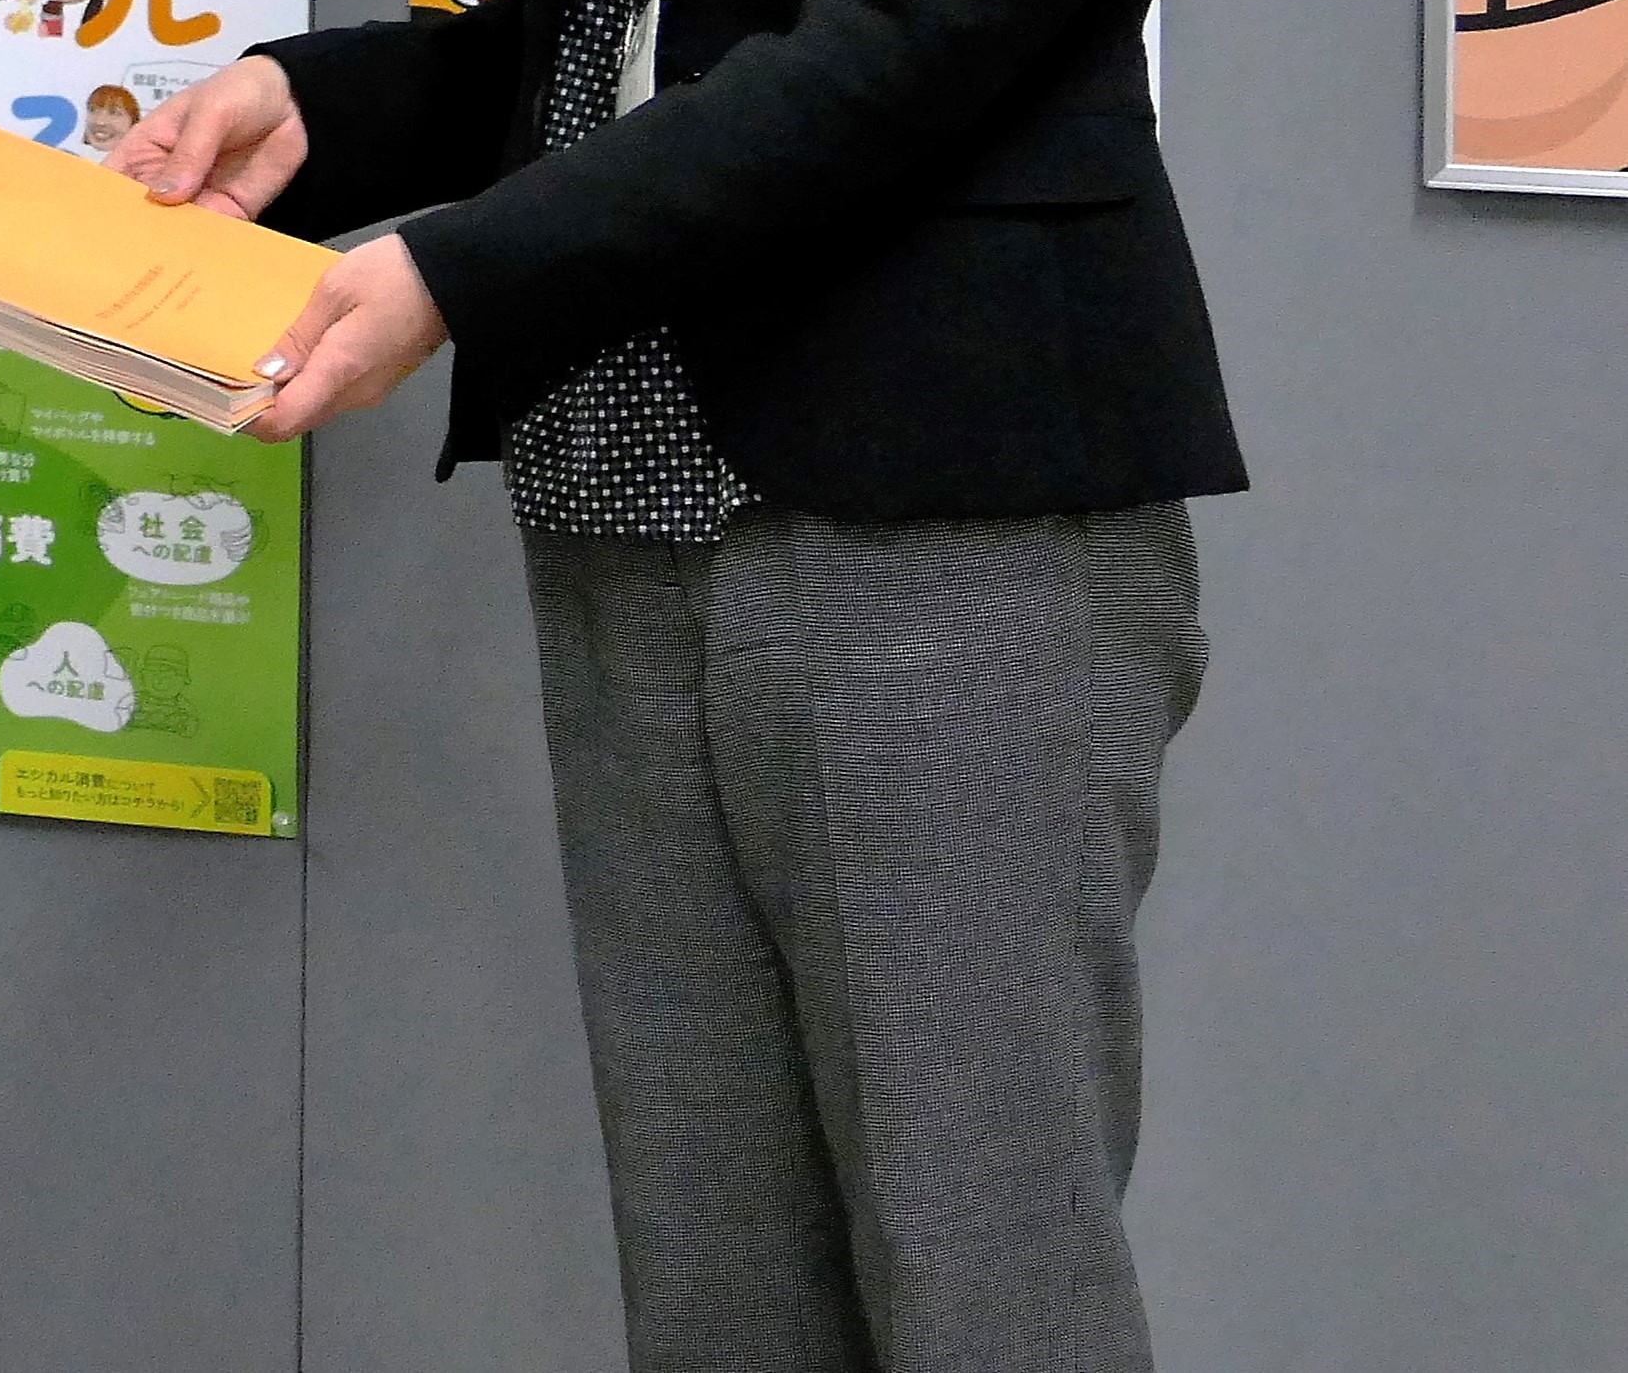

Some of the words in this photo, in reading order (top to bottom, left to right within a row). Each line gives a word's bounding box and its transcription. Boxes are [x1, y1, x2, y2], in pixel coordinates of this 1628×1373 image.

[139, 512, 206, 542] 社会
[133, 543, 213, 564] への配慮
[53, 651, 79, 676] 人
[26, 680, 105, 701] への配慮
